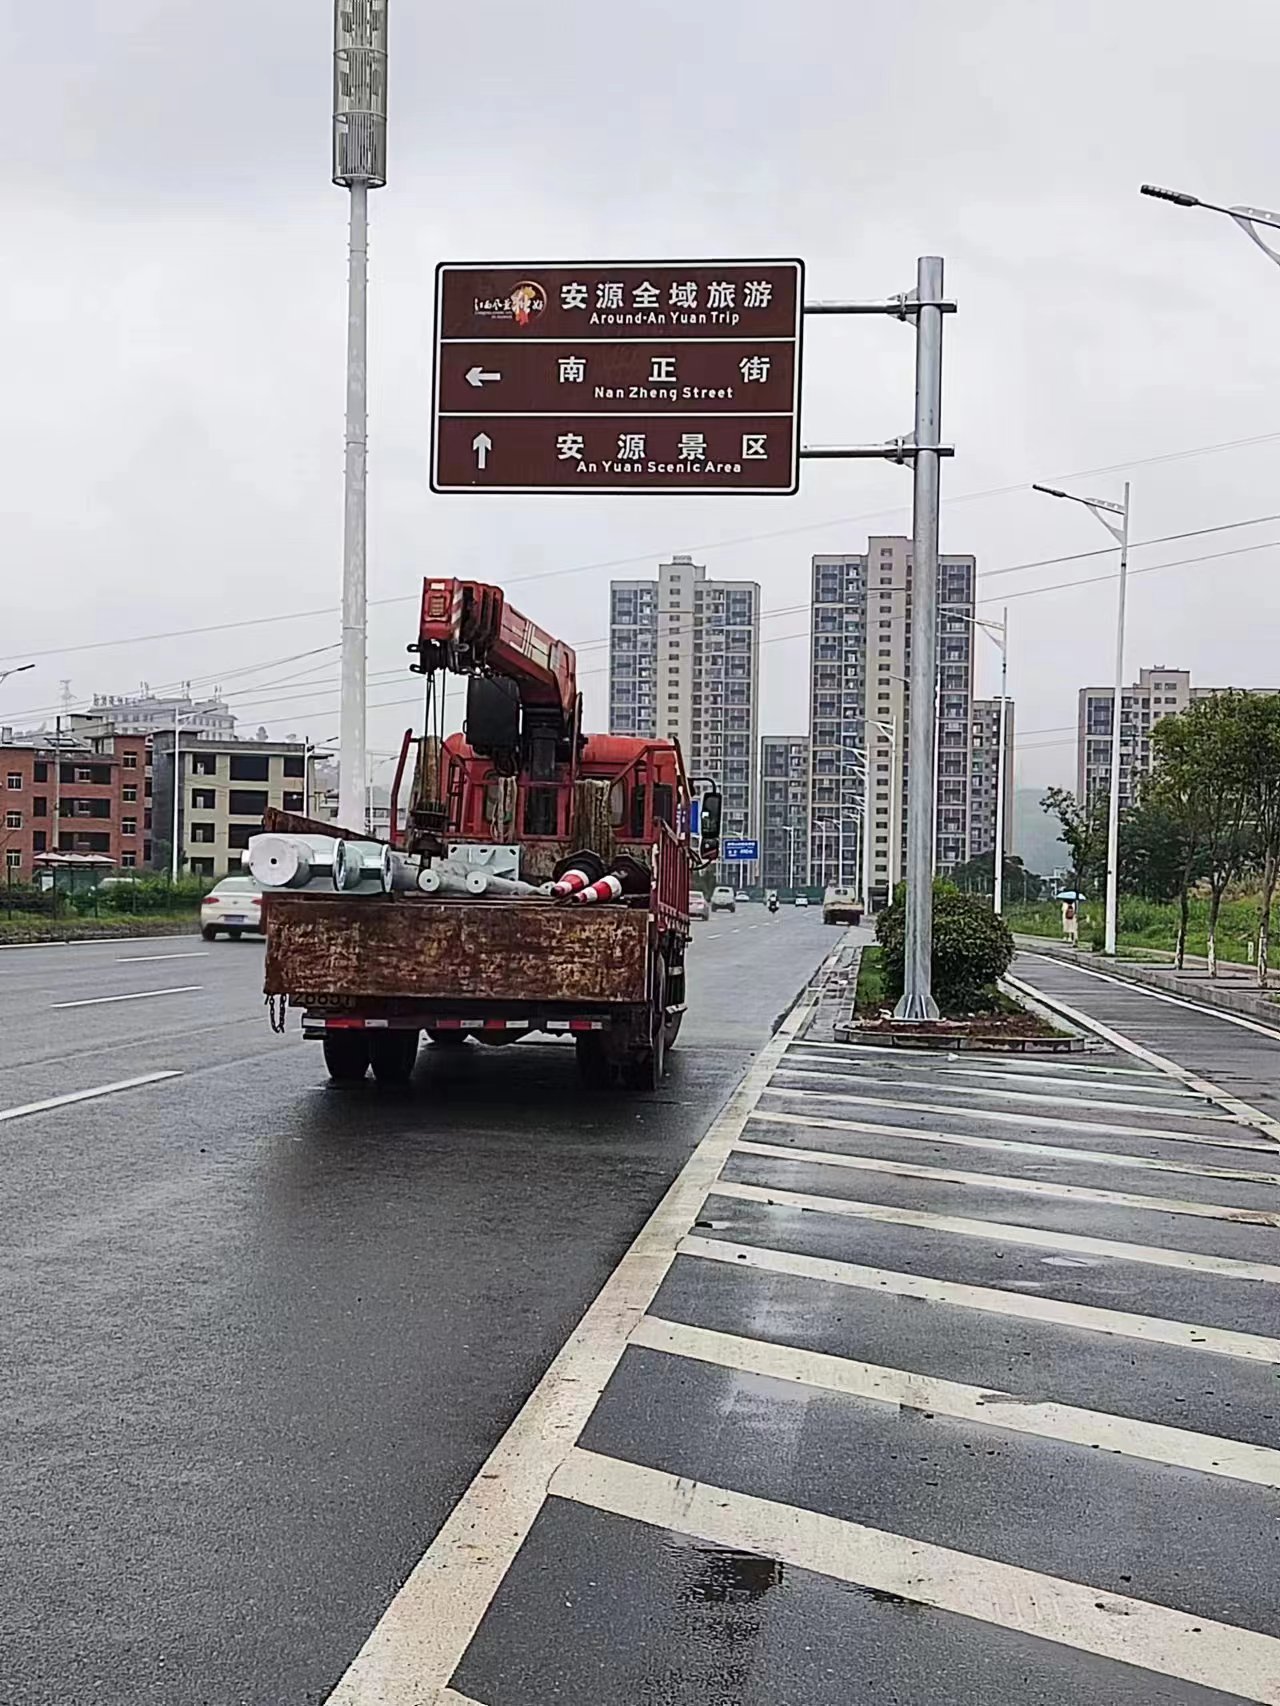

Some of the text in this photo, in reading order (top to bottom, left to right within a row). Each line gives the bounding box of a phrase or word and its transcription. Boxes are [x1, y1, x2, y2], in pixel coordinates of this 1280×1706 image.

[560, 281, 773, 310] 安源全域旅游
[671, 312, 706, 324] Yuan
[710, 311, 740, 326] Trip
[557, 355, 771, 383] 南正街
[594, 386, 733, 402] Nan Zheng Street
[556, 433, 768, 461] 安源景区
[576, 459, 742, 473] An Yuan Scenic Area
